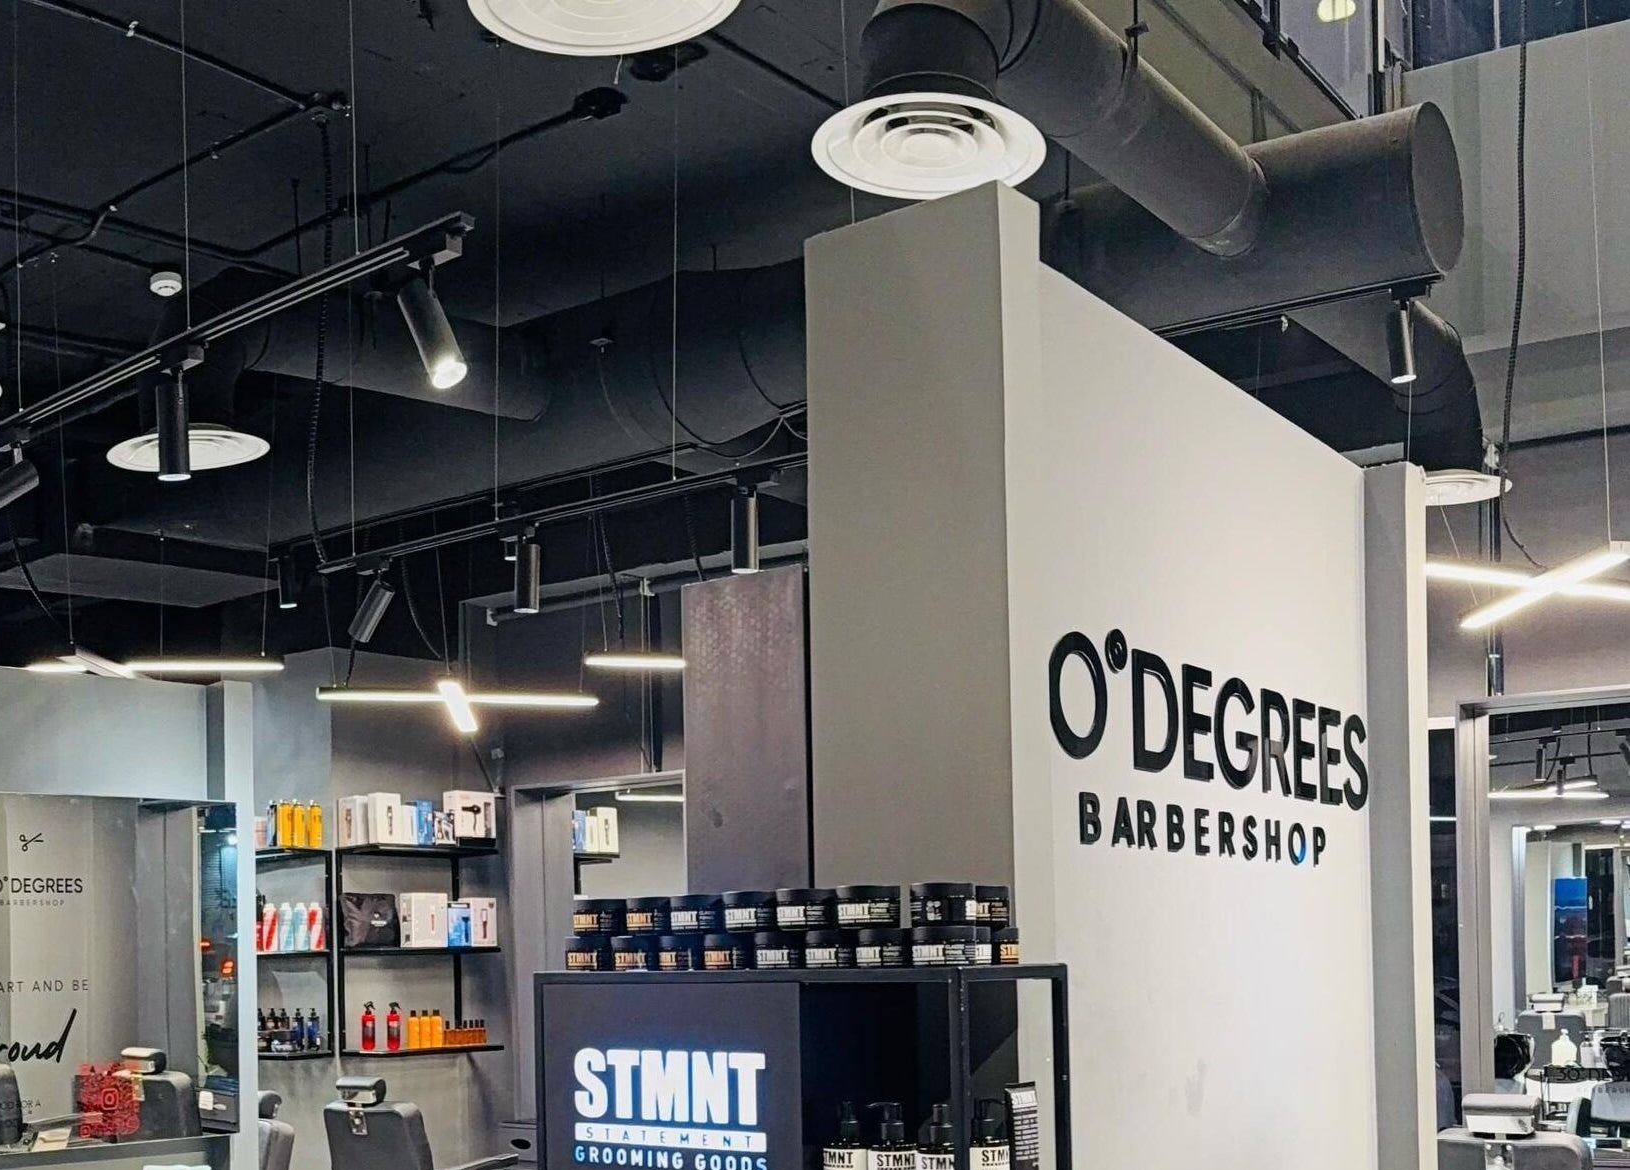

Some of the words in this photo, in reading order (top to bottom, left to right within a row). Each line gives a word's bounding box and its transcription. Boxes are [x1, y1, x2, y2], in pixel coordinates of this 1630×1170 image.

[1079, 791, 1326, 867] BARBERSHOP
[0, 899, 65, 907] BARBERSHOP
[32, 980, 63, 992] AND
[72, 979, 89, 991] BE
[574, 1047, 766, 1125] STMNT
[586, 1126, 752, 1148] STATEMENT
[574, 1145, 684, 1170] GROOMING
[876, 1153, 915, 1166] STMNT
